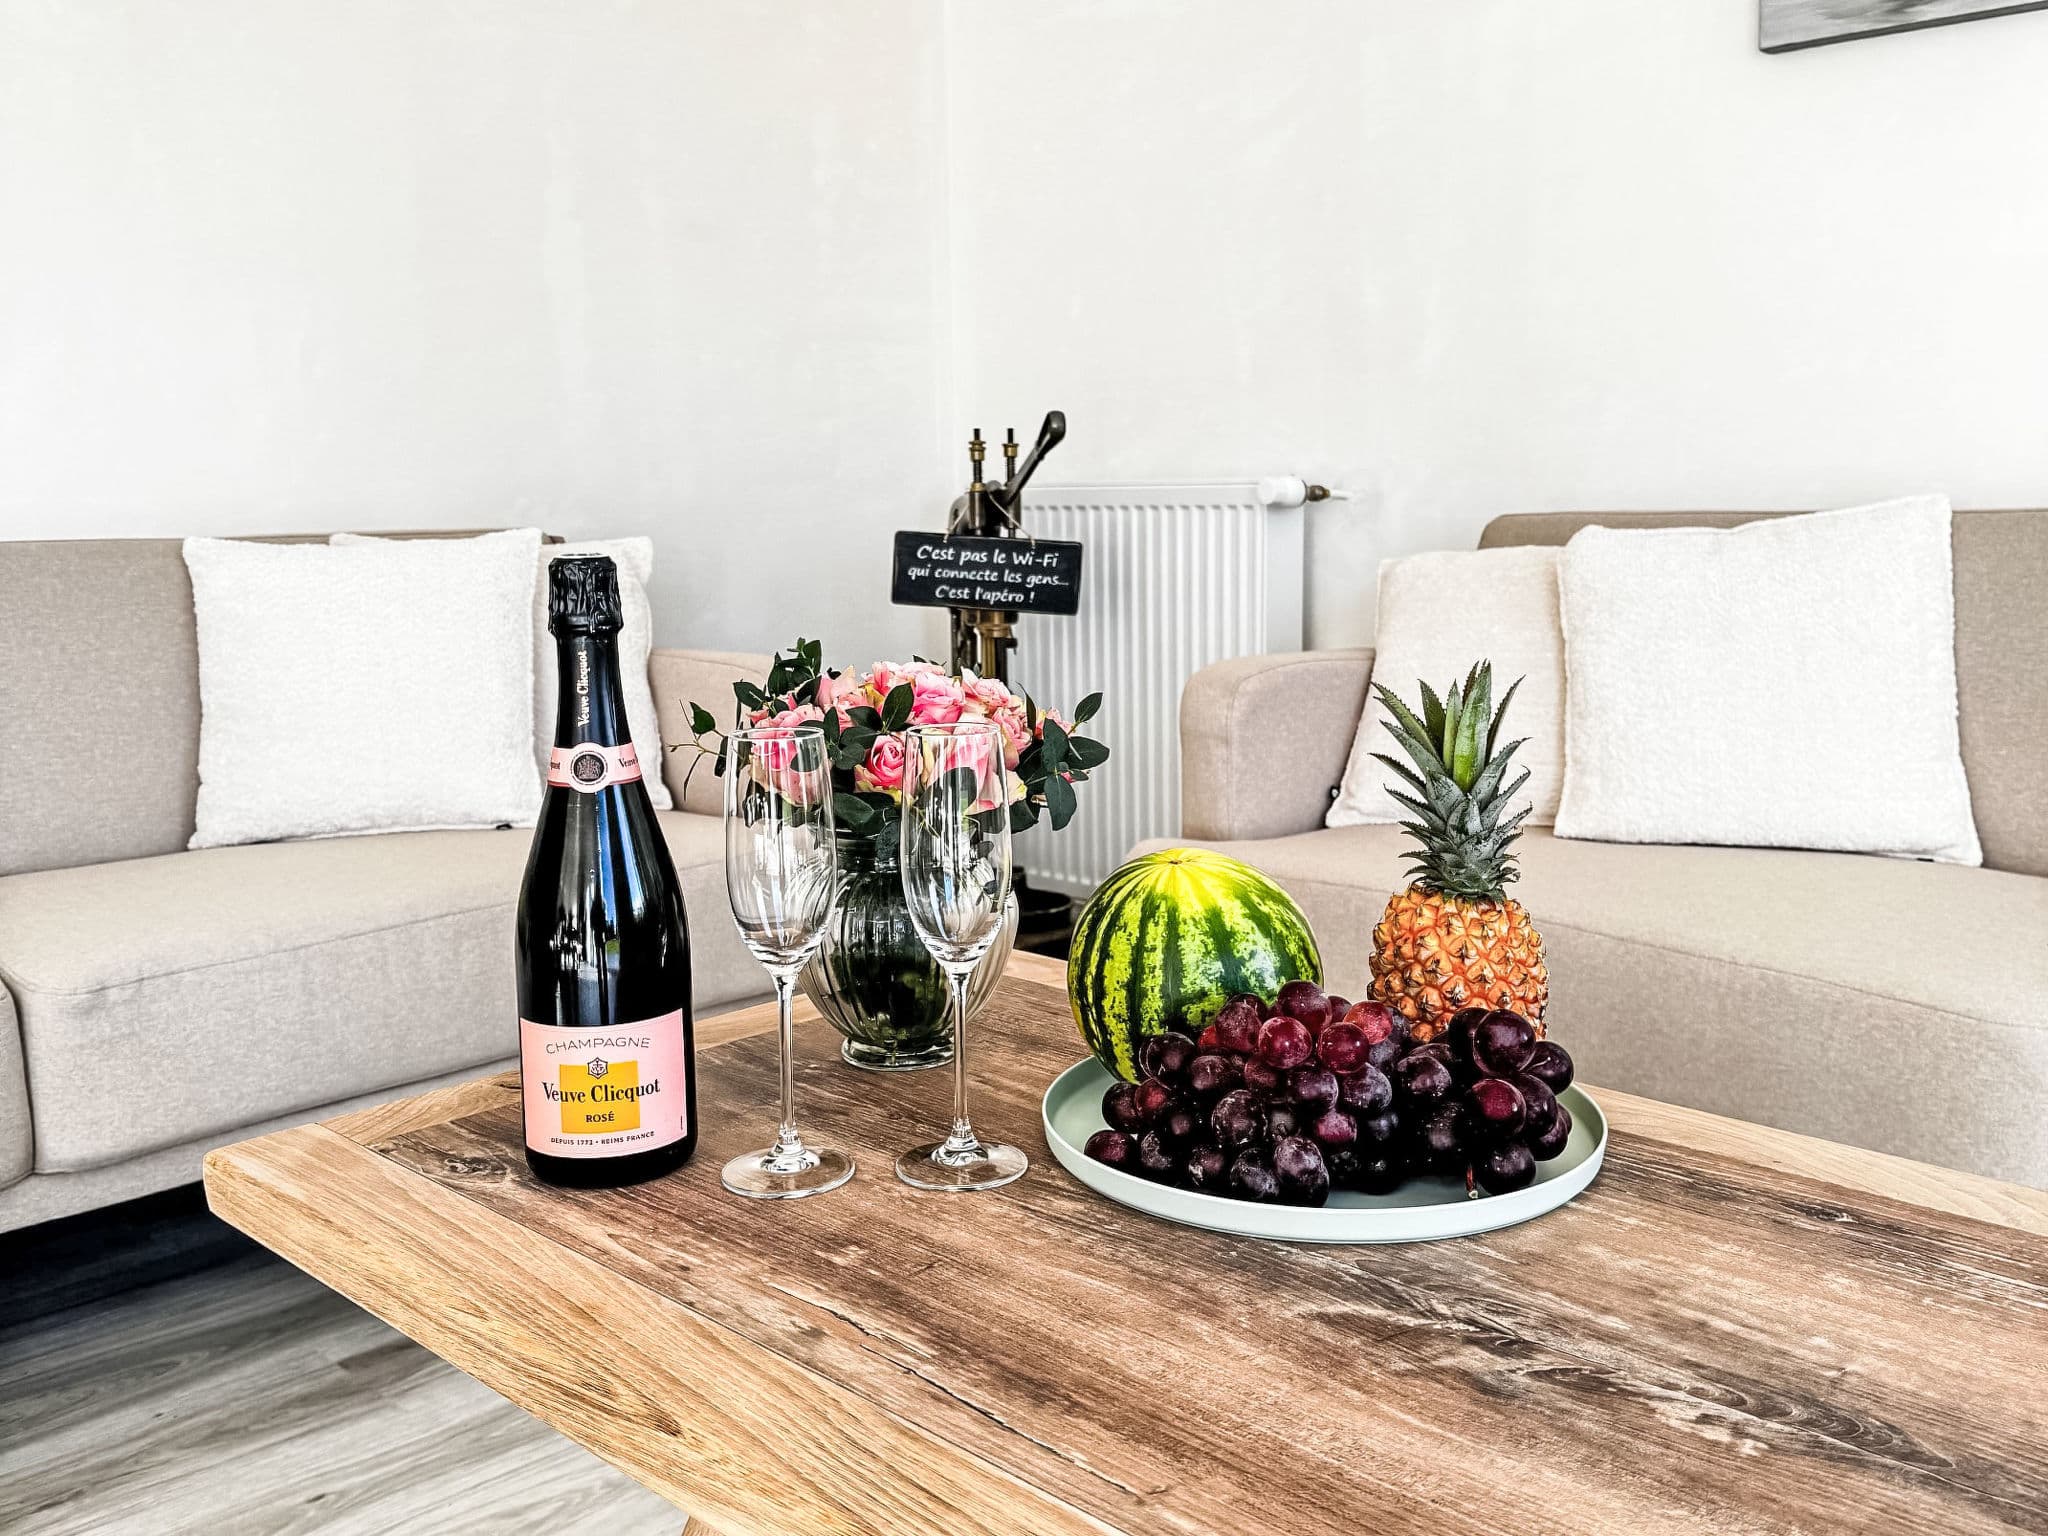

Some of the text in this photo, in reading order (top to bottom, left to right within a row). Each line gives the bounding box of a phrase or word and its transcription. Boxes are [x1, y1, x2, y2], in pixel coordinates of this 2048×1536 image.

[916, 545, 1060, 568] C'est pas le Wi-Fi
[907, 564, 932, 580] qui
[934, 566, 999, 582] connecte
[1003, 569, 1022, 583] les
[935, 585, 1035, 605] C'est l'apéro !
[576, 650, 591, 727] Veuve Clicquot
[546, 1037, 651, 1055] CHAMPAGNE
[542, 1078, 661, 1104] Veuve Clicquot
[585, 1111, 615, 1123] ROSÉ
[550, 1137, 575, 1146] DEPUIS
[601, 1136, 624, 1145] REIMS
[626, 1130, 655, 1142] FRANCE
